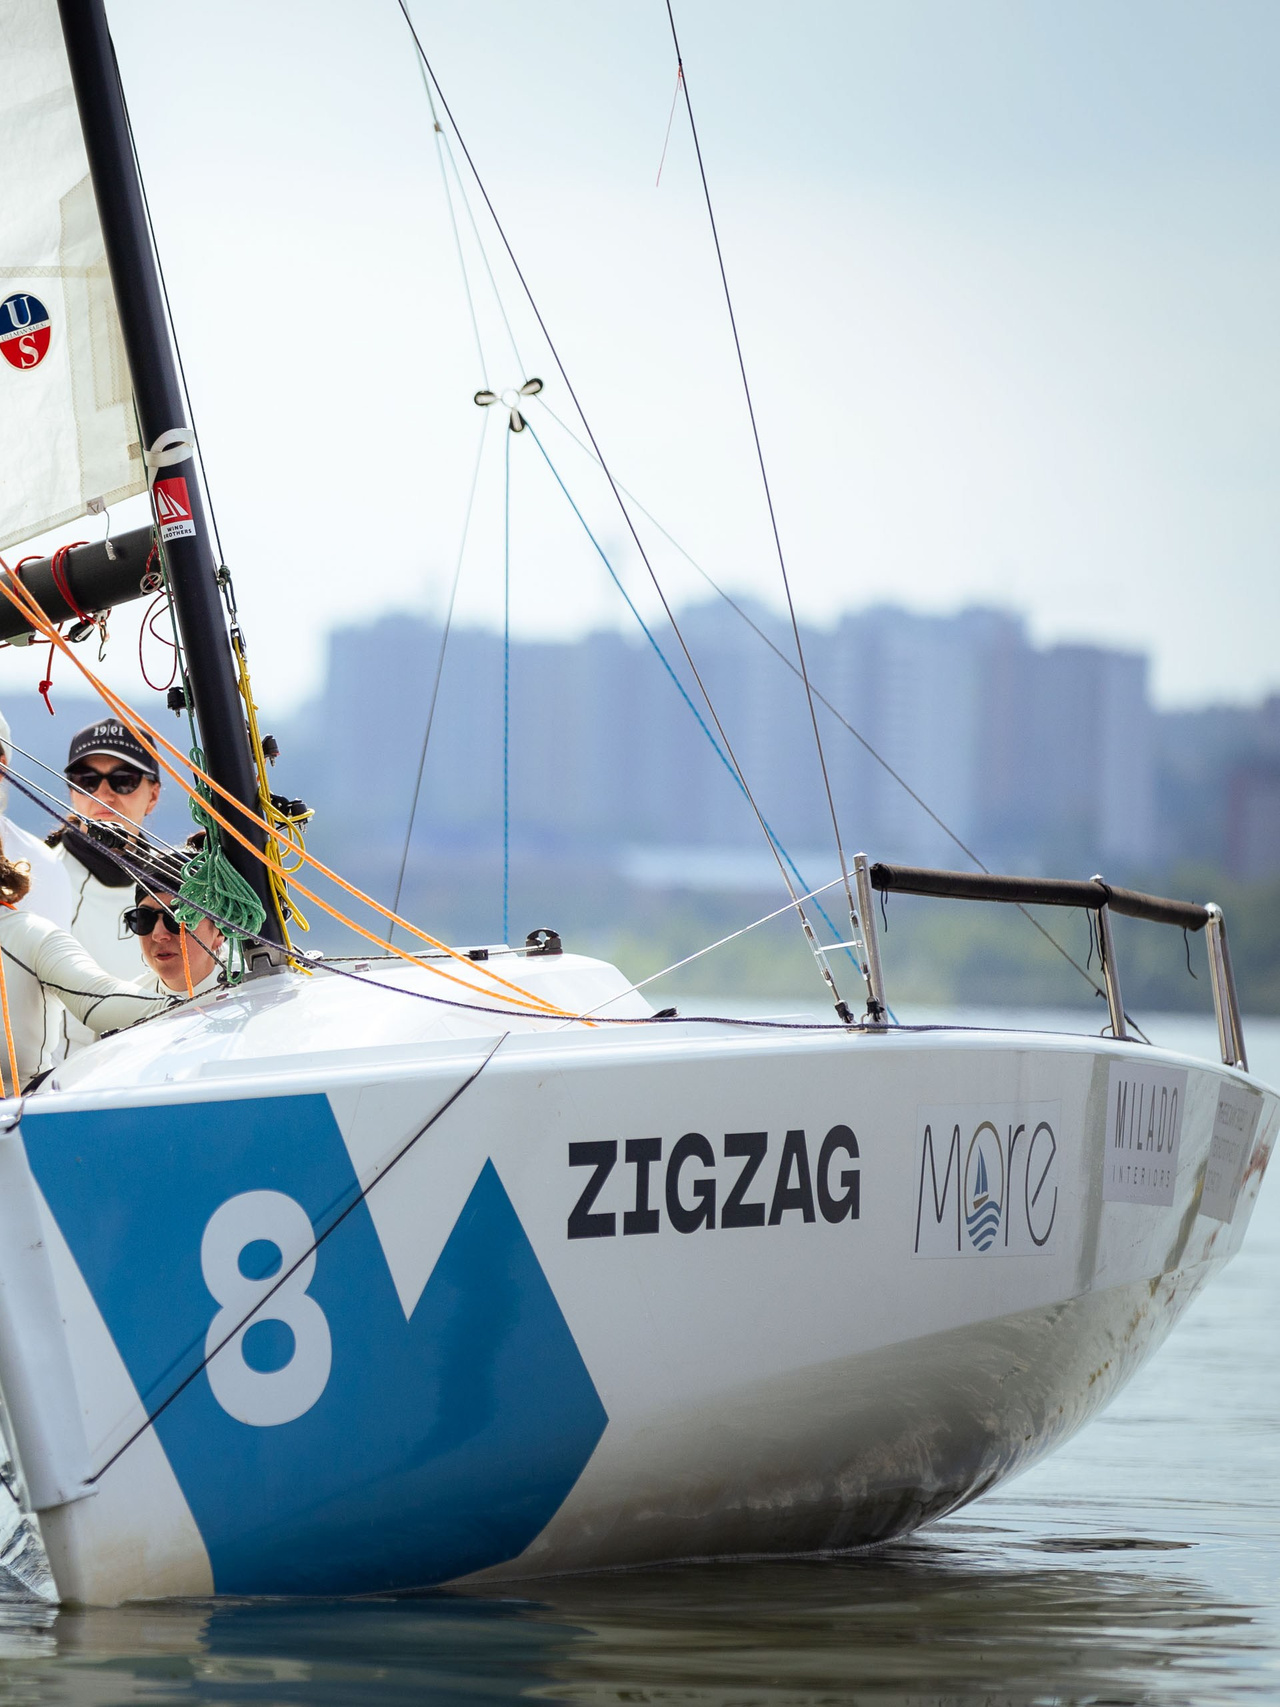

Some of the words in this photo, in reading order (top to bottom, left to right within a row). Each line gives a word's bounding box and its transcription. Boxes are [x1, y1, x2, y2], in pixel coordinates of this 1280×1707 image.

[4, 295, 30, 329] U
[18, 333, 39, 369] S
[166, 524, 184, 533] WIND
[1114, 1080, 1178, 1154] MILADO
[567, 1124, 861, 1240] ZIGZAG
[1112, 1165, 1171, 1188] INTERIORS
[201, 1189, 332, 1427] 8
